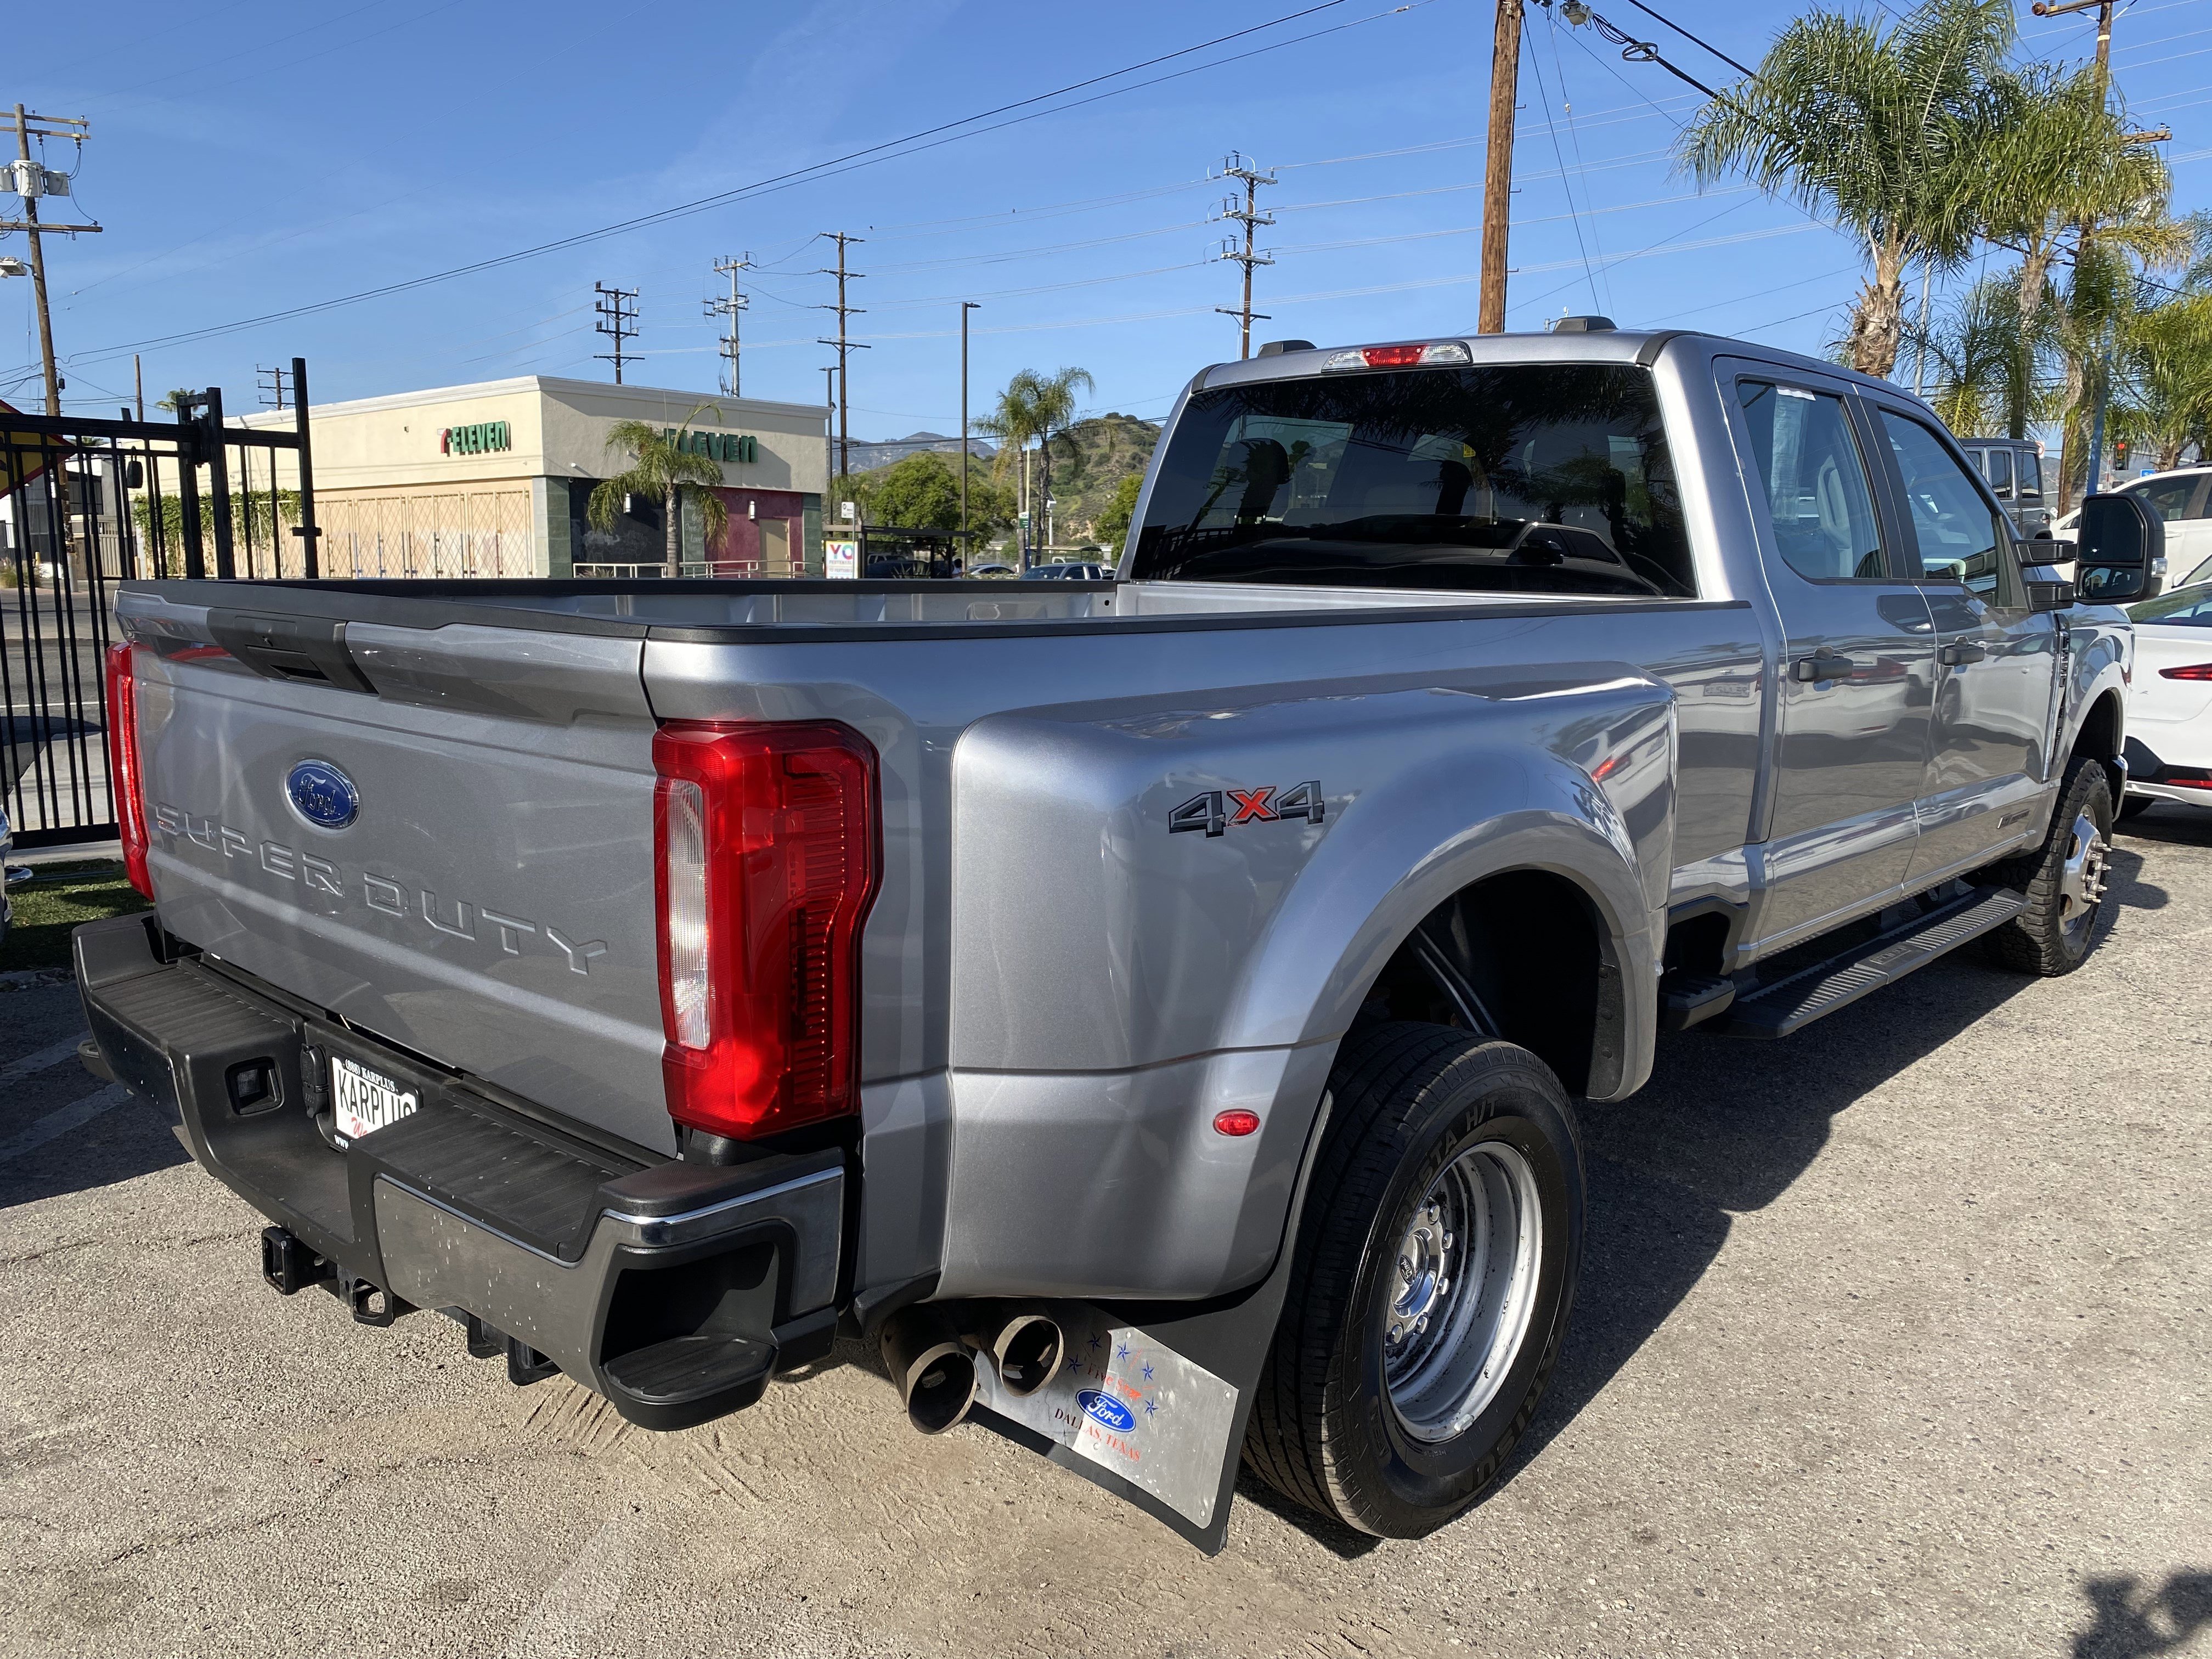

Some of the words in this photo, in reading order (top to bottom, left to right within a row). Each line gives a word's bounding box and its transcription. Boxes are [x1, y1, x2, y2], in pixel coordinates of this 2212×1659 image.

[155, 802, 345, 898] SUPER
[363, 871, 608, 976] DUTY
[345, 1059, 360, 1075] (888)
[361, 1067, 396, 1092] KARPLUS
[1087, 1396, 1125, 1426] Ford
[1105, 1433, 1141, 1462] TEXAS
